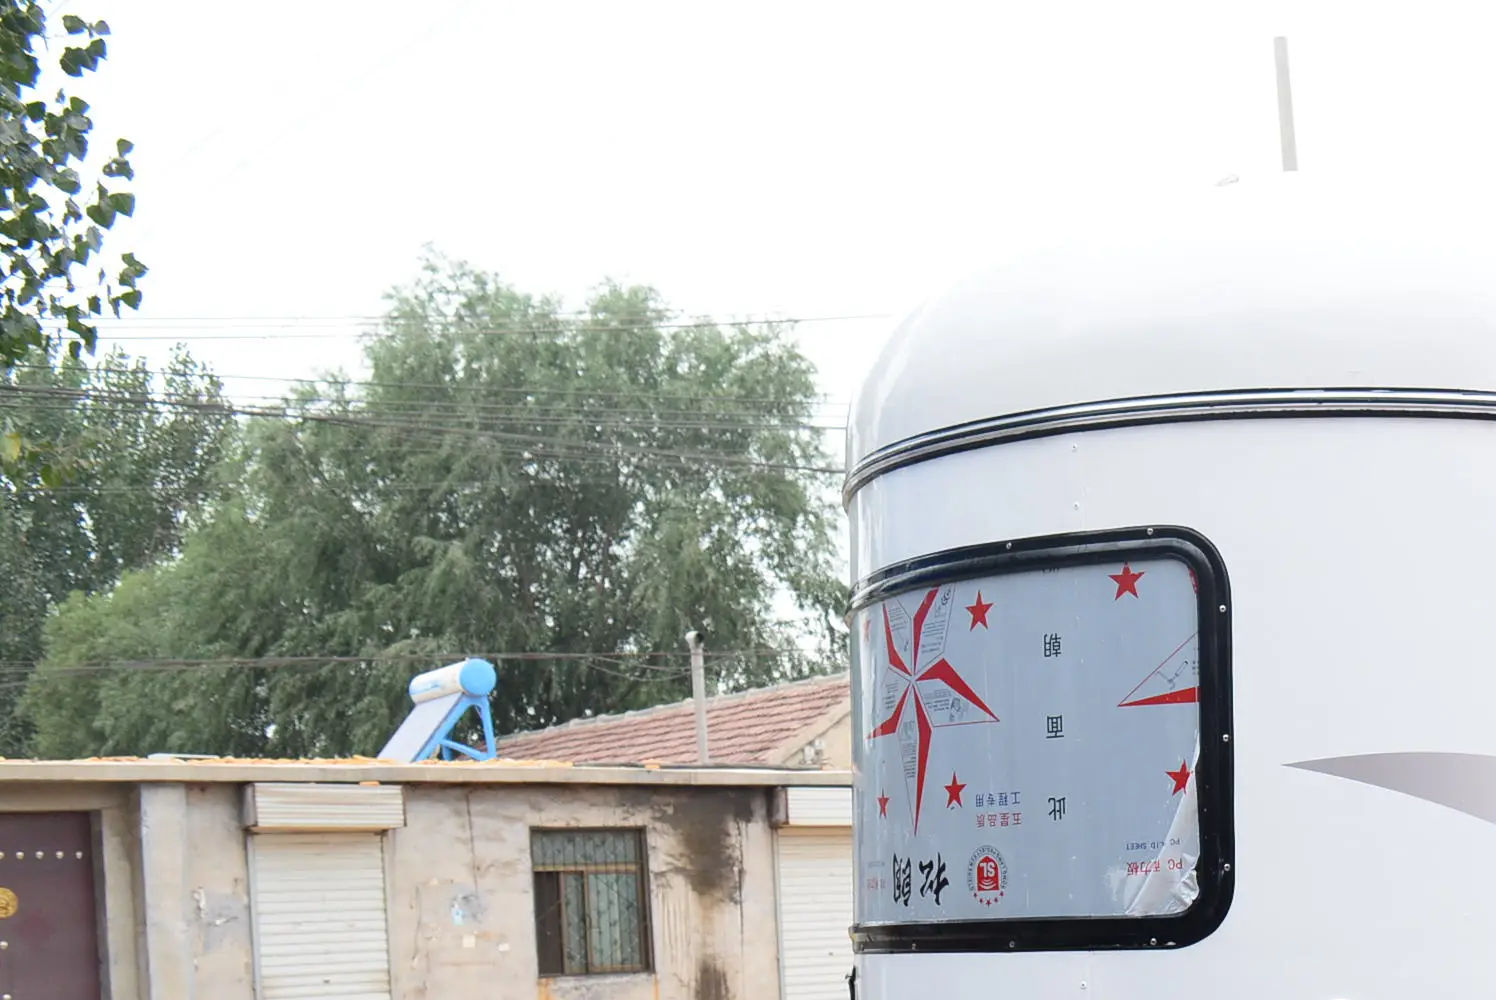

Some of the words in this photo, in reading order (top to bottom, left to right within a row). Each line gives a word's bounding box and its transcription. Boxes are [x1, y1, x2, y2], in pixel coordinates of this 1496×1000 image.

[975, 791, 1021, 808] 工程专用
[975, 811, 1022, 829] 五星品质
[1126, 842, 1147, 851] SHEET
[979, 861, 996, 879] SL
[1168, 858, 1183, 870] PC
[891, 851, 950, 907] 松朗
